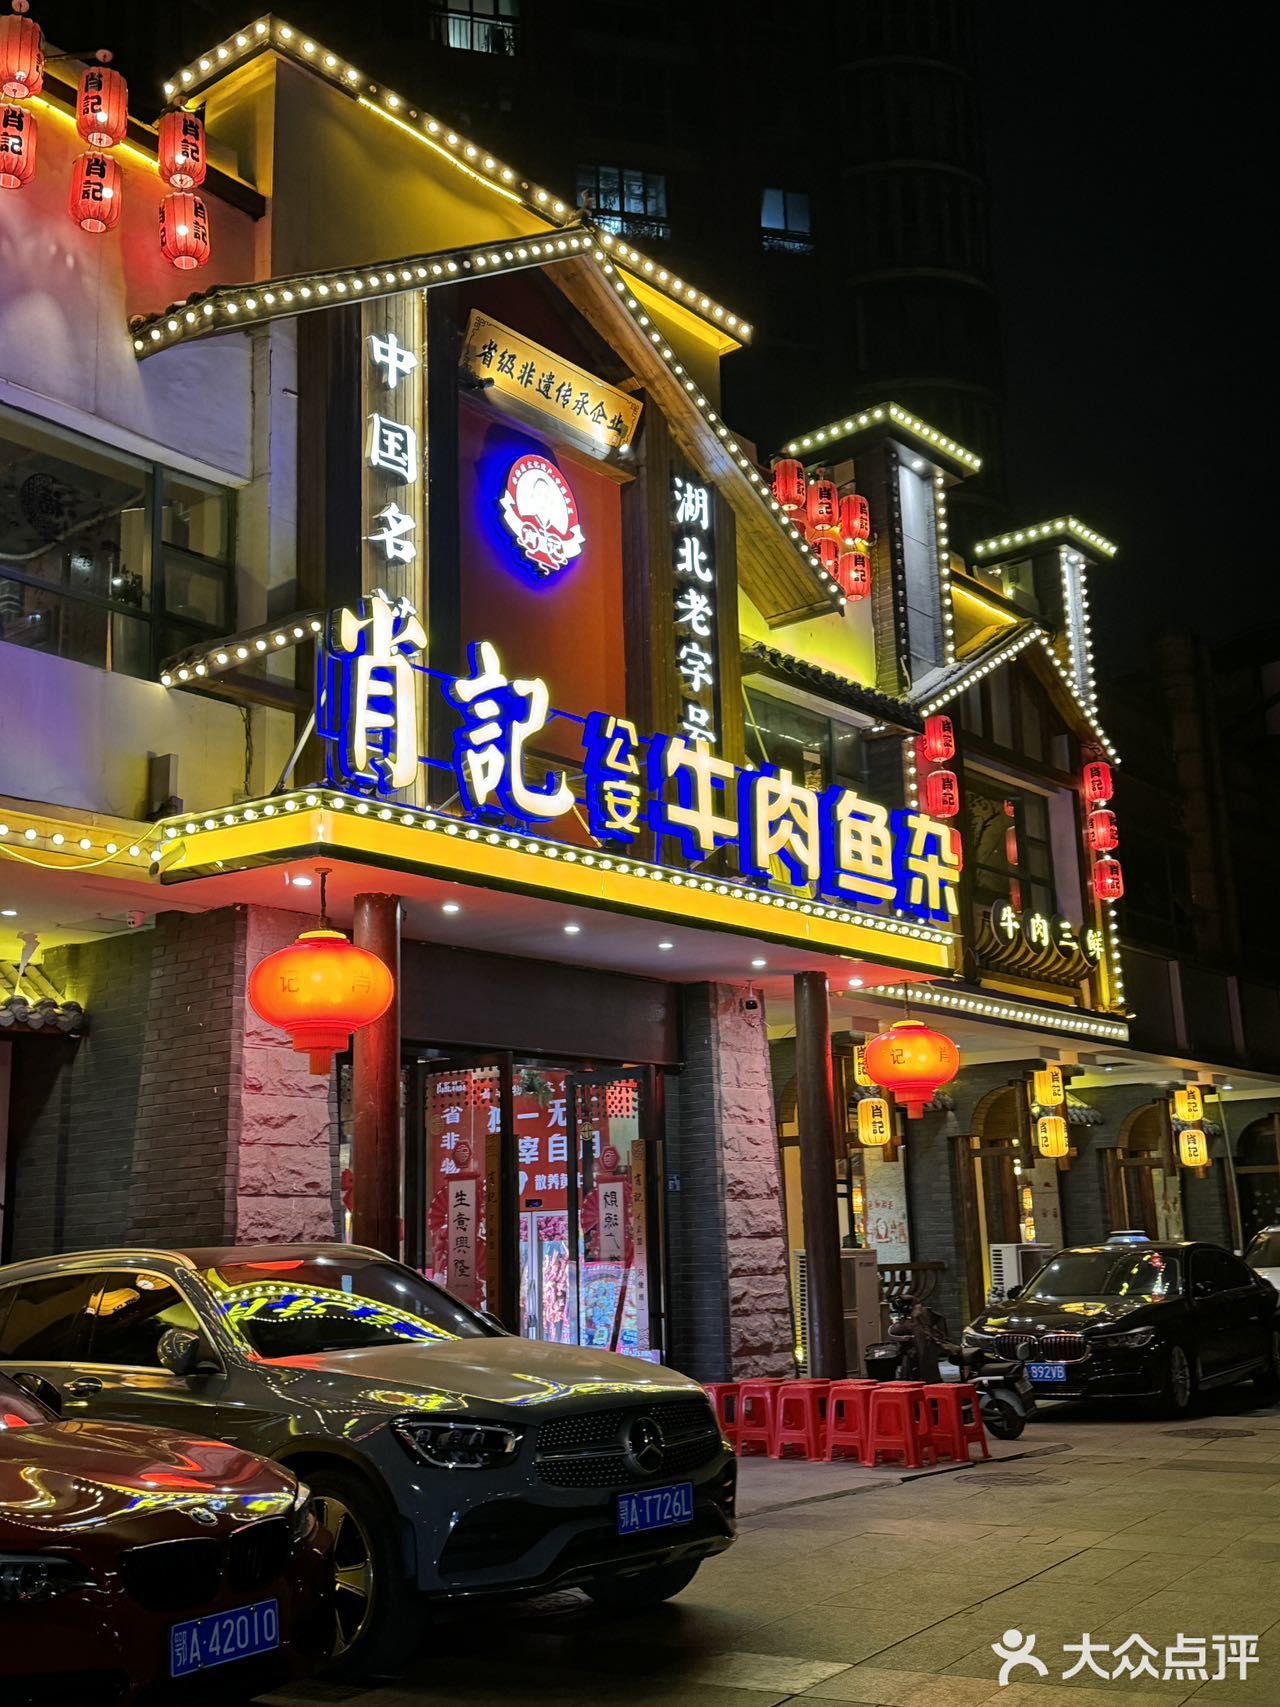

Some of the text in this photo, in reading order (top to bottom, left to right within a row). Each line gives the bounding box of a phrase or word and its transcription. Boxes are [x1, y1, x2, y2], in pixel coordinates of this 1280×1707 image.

[83, 72, 104, 117] 肖記
[82, 157, 107, 202] 肖記
[474, 338, 625, 434] 省级非遗传承企业
[818, 487, 833, 516] 肖記
[674, 475, 718, 743] 湖北老字号
[341, 595, 961, 916] 肖記 公安 牛肉鱼杂
[871, 1104, 885, 1135] 肖記
[1186, 1133, 1199, 1158] 肖記
